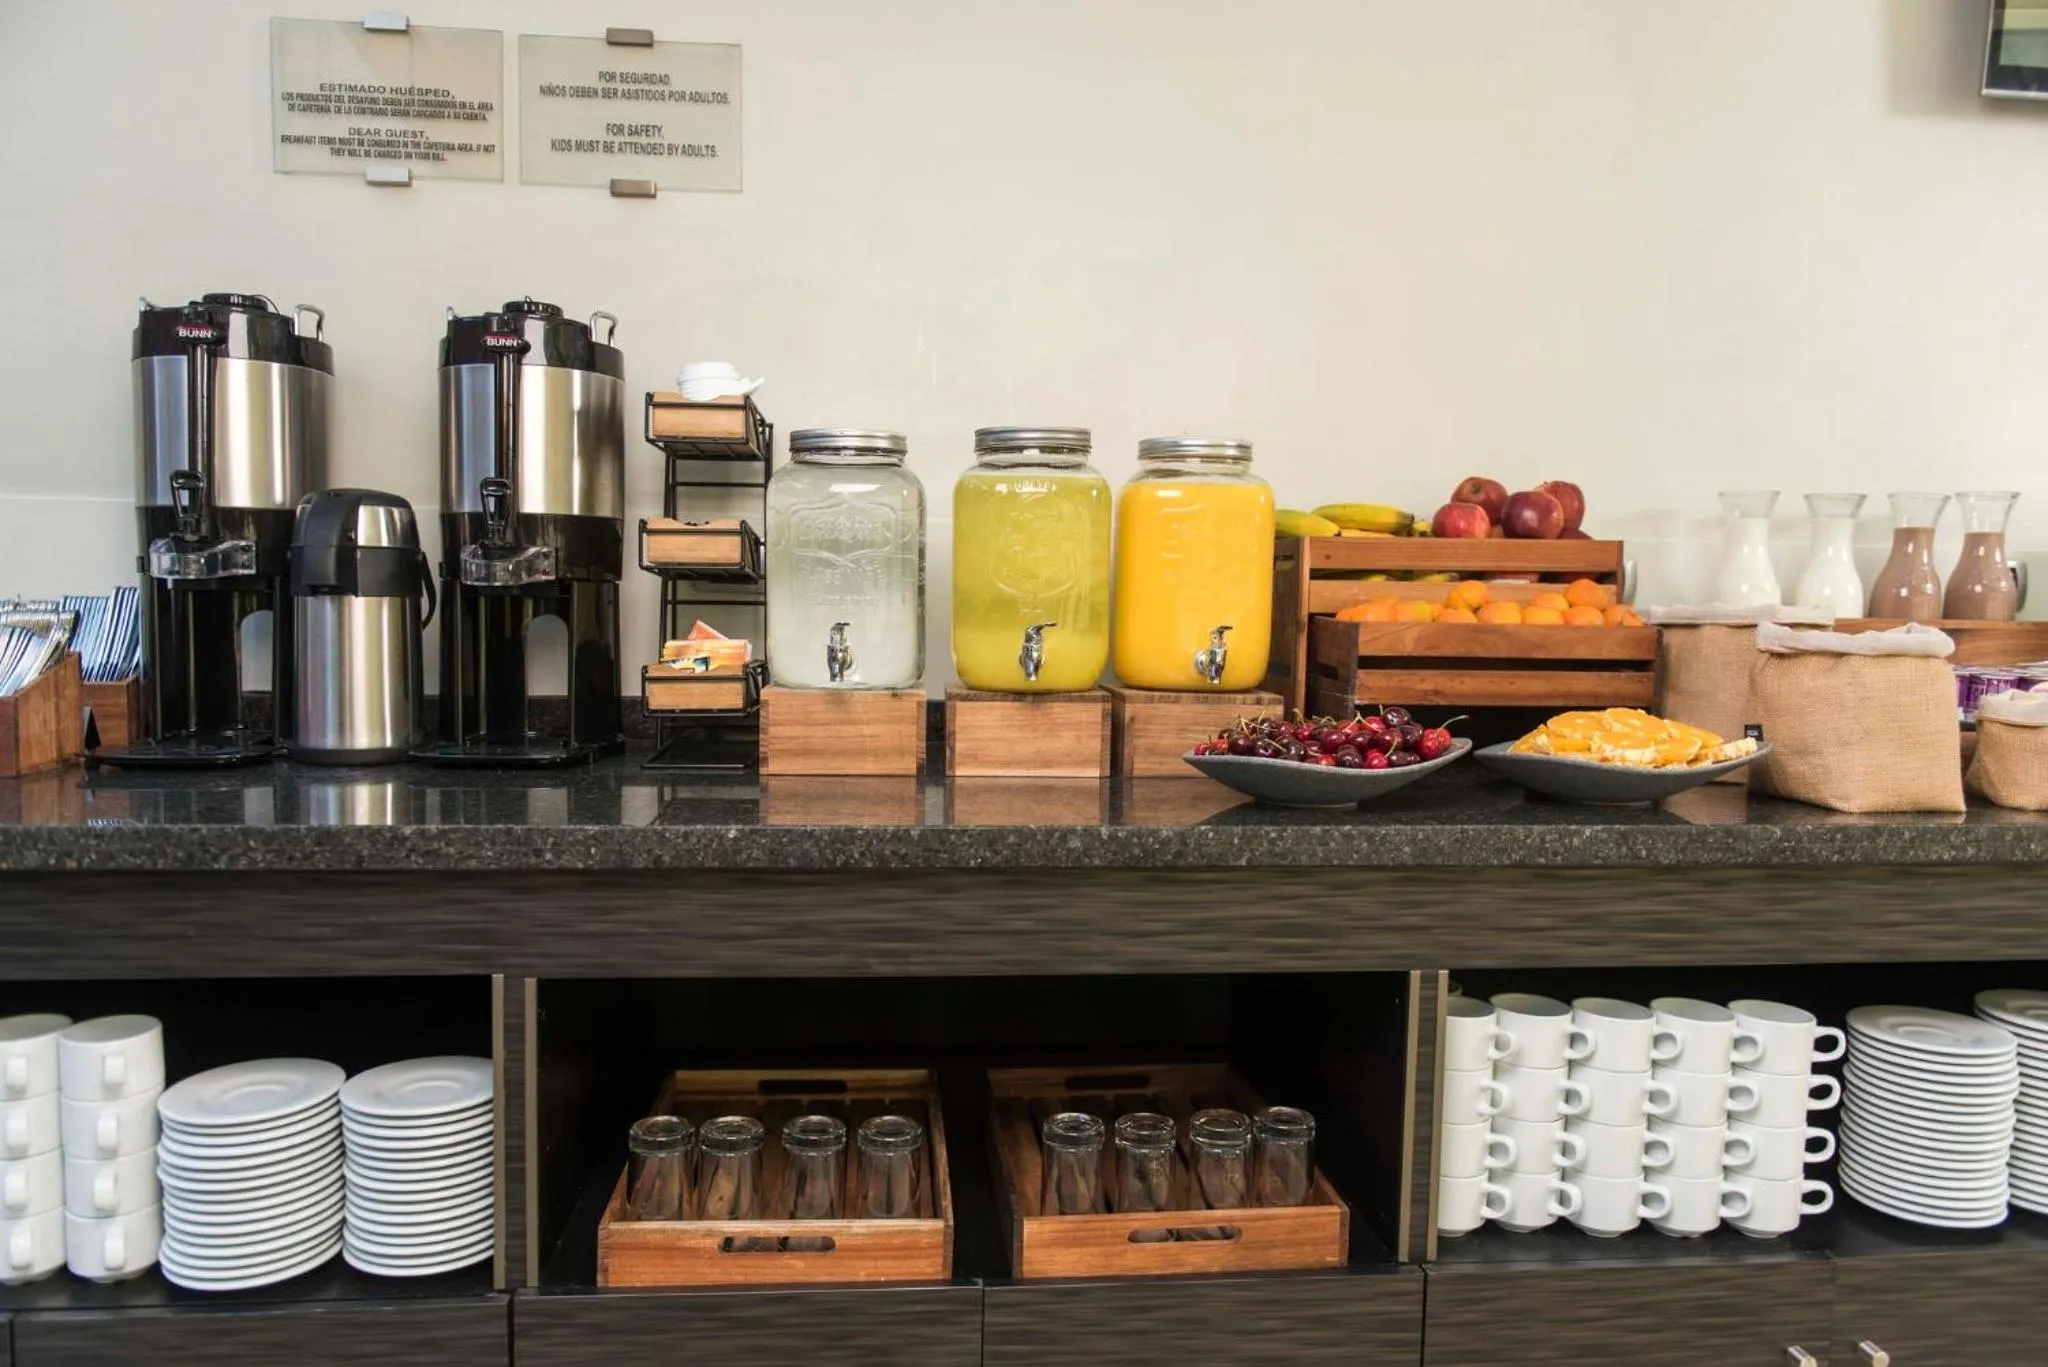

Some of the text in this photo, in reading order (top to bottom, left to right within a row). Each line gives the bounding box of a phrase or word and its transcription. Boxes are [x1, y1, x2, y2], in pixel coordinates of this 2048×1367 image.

[599, 71, 617, 83] POR
[281, 91, 294, 101] LOS
[296, 92, 333, 103] PRODUCTOS
[334, 94, 345, 104] DEL
[347, 95, 380, 106] DESAYUNO
[319, 83, 455, 100] ESTIMADO HUÉSPED,
[539, 82, 567, 97] NIÑOS
[569, 86, 599, 99] DEBEN
[601, 86, 618, 100] SER
[620, 88, 666, 101] ASISTIDOS
[669, 90, 687, 102] POR
[287, 103, 296, 112] DE
[334, 105, 343, 114] DE
[412, 109, 446, 119] CARGADOS
[348, 127, 429, 140] DEAR GUEST,
[606, 123, 664, 140] FOR SAFETY,
[280, 134, 316, 145] BREAKFAST
[317, 136, 337, 146] ITEMS
[338, 136, 356, 147] MUST
[357, 138, 365, 147] BE
[366, 138, 400, 149] CONSUMED
[402, 139, 409, 149] IN
[410, 140, 422, 150] THE
[483, 144, 496, 153] NOT
[551, 138, 719, 158] KIDS MUST BE ATTENDED BY ADULTS.
[329, 146, 345, 157] THEY
[346, 147, 362, 157] WILL
[364, 148, 372, 158] BE
[373, 149, 402, 159] CHARGED
[403, 150, 413, 160] ON
[414, 150, 431, 161] YOUR
[178, 328, 212, 338] BUNN
[487, 338, 517, 347] BUNN
